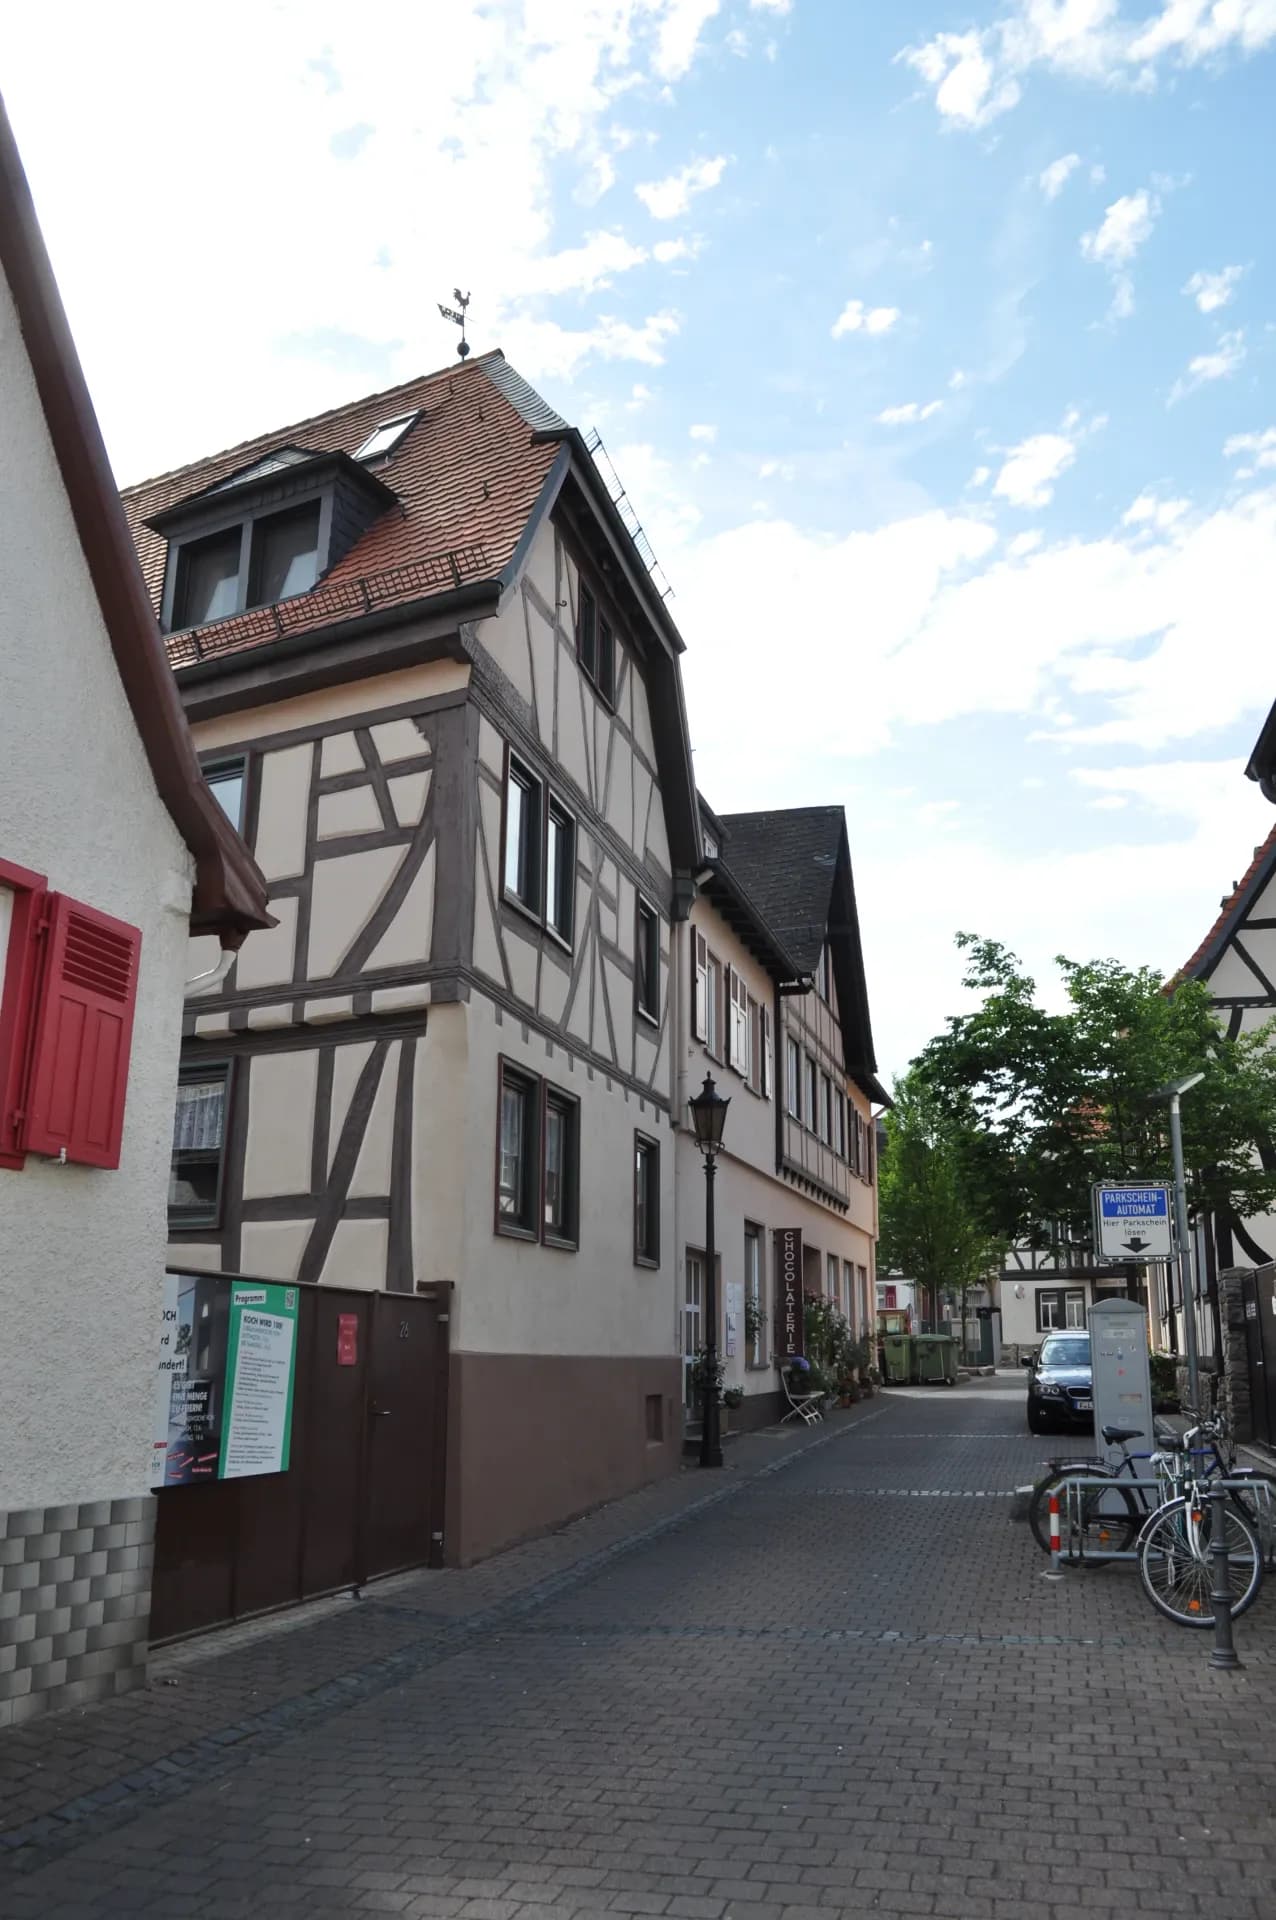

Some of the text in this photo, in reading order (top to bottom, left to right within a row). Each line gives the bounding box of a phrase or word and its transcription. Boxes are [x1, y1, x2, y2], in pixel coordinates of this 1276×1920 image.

[1105, 1191, 1163, 1204] PARKSCHEIN-
[1117, 1204, 1156, 1216] AUTOMAT
[1123, 1219, 1167, 1227] Parkschein
[1125, 1228, 1146, 1236] lösen
[784, 1231, 796, 1354] CHOCOLATERIE
[235, 1294, 265, 1305] Programm:
[243, 1315, 259, 1325] KOCH
[400, 1320, 409, 1338] 26
[187, 1391, 209, 1401] MENGE
